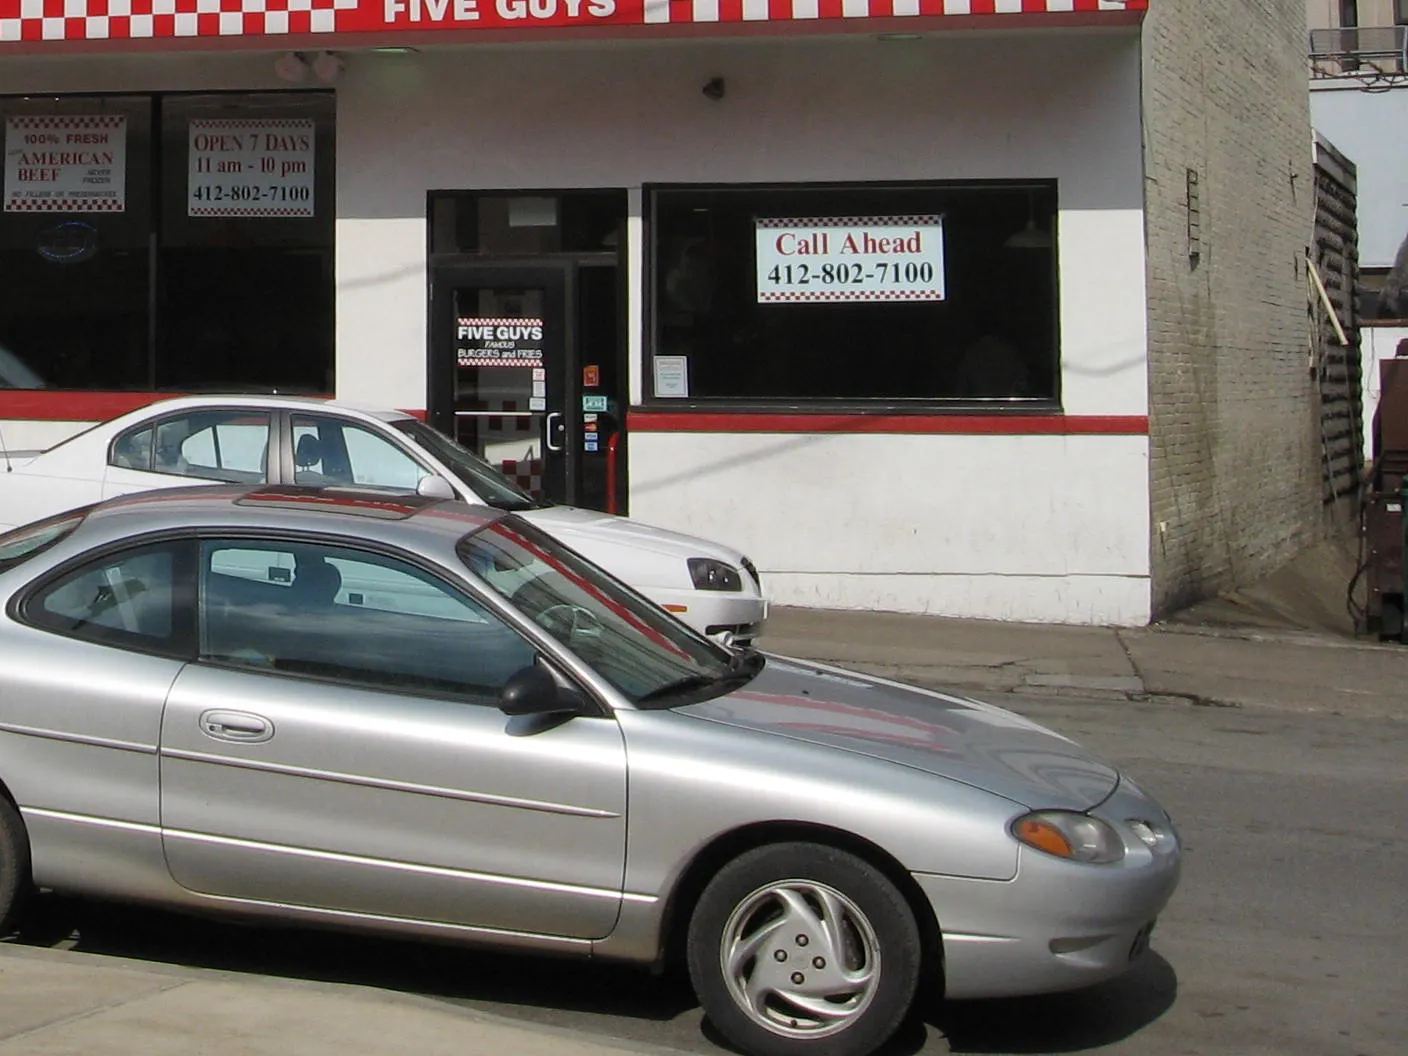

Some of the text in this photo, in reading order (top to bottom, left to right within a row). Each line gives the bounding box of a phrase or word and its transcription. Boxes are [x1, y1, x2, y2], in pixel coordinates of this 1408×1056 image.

[25, 133, 108, 144] 100% FRESH
[194, 134, 310, 151] OPEN 7 DAYS
[18, 152, 114, 165] AMERICAN
[197, 157, 211, 173] 11
[217, 161, 242, 173] am
[261, 157, 275, 173] 10
[281, 161, 307, 177] pm
[17, 168, 61, 182] BEEF
[193, 186, 310, 201] 412-802-7100
[776, 231, 921, 255] Call Ahead
[767, 262, 933, 284] 412-802-7100
[457, 326, 543, 340] FIVE GUYS
[457, 349, 543, 358] BURGERS and FRIES
